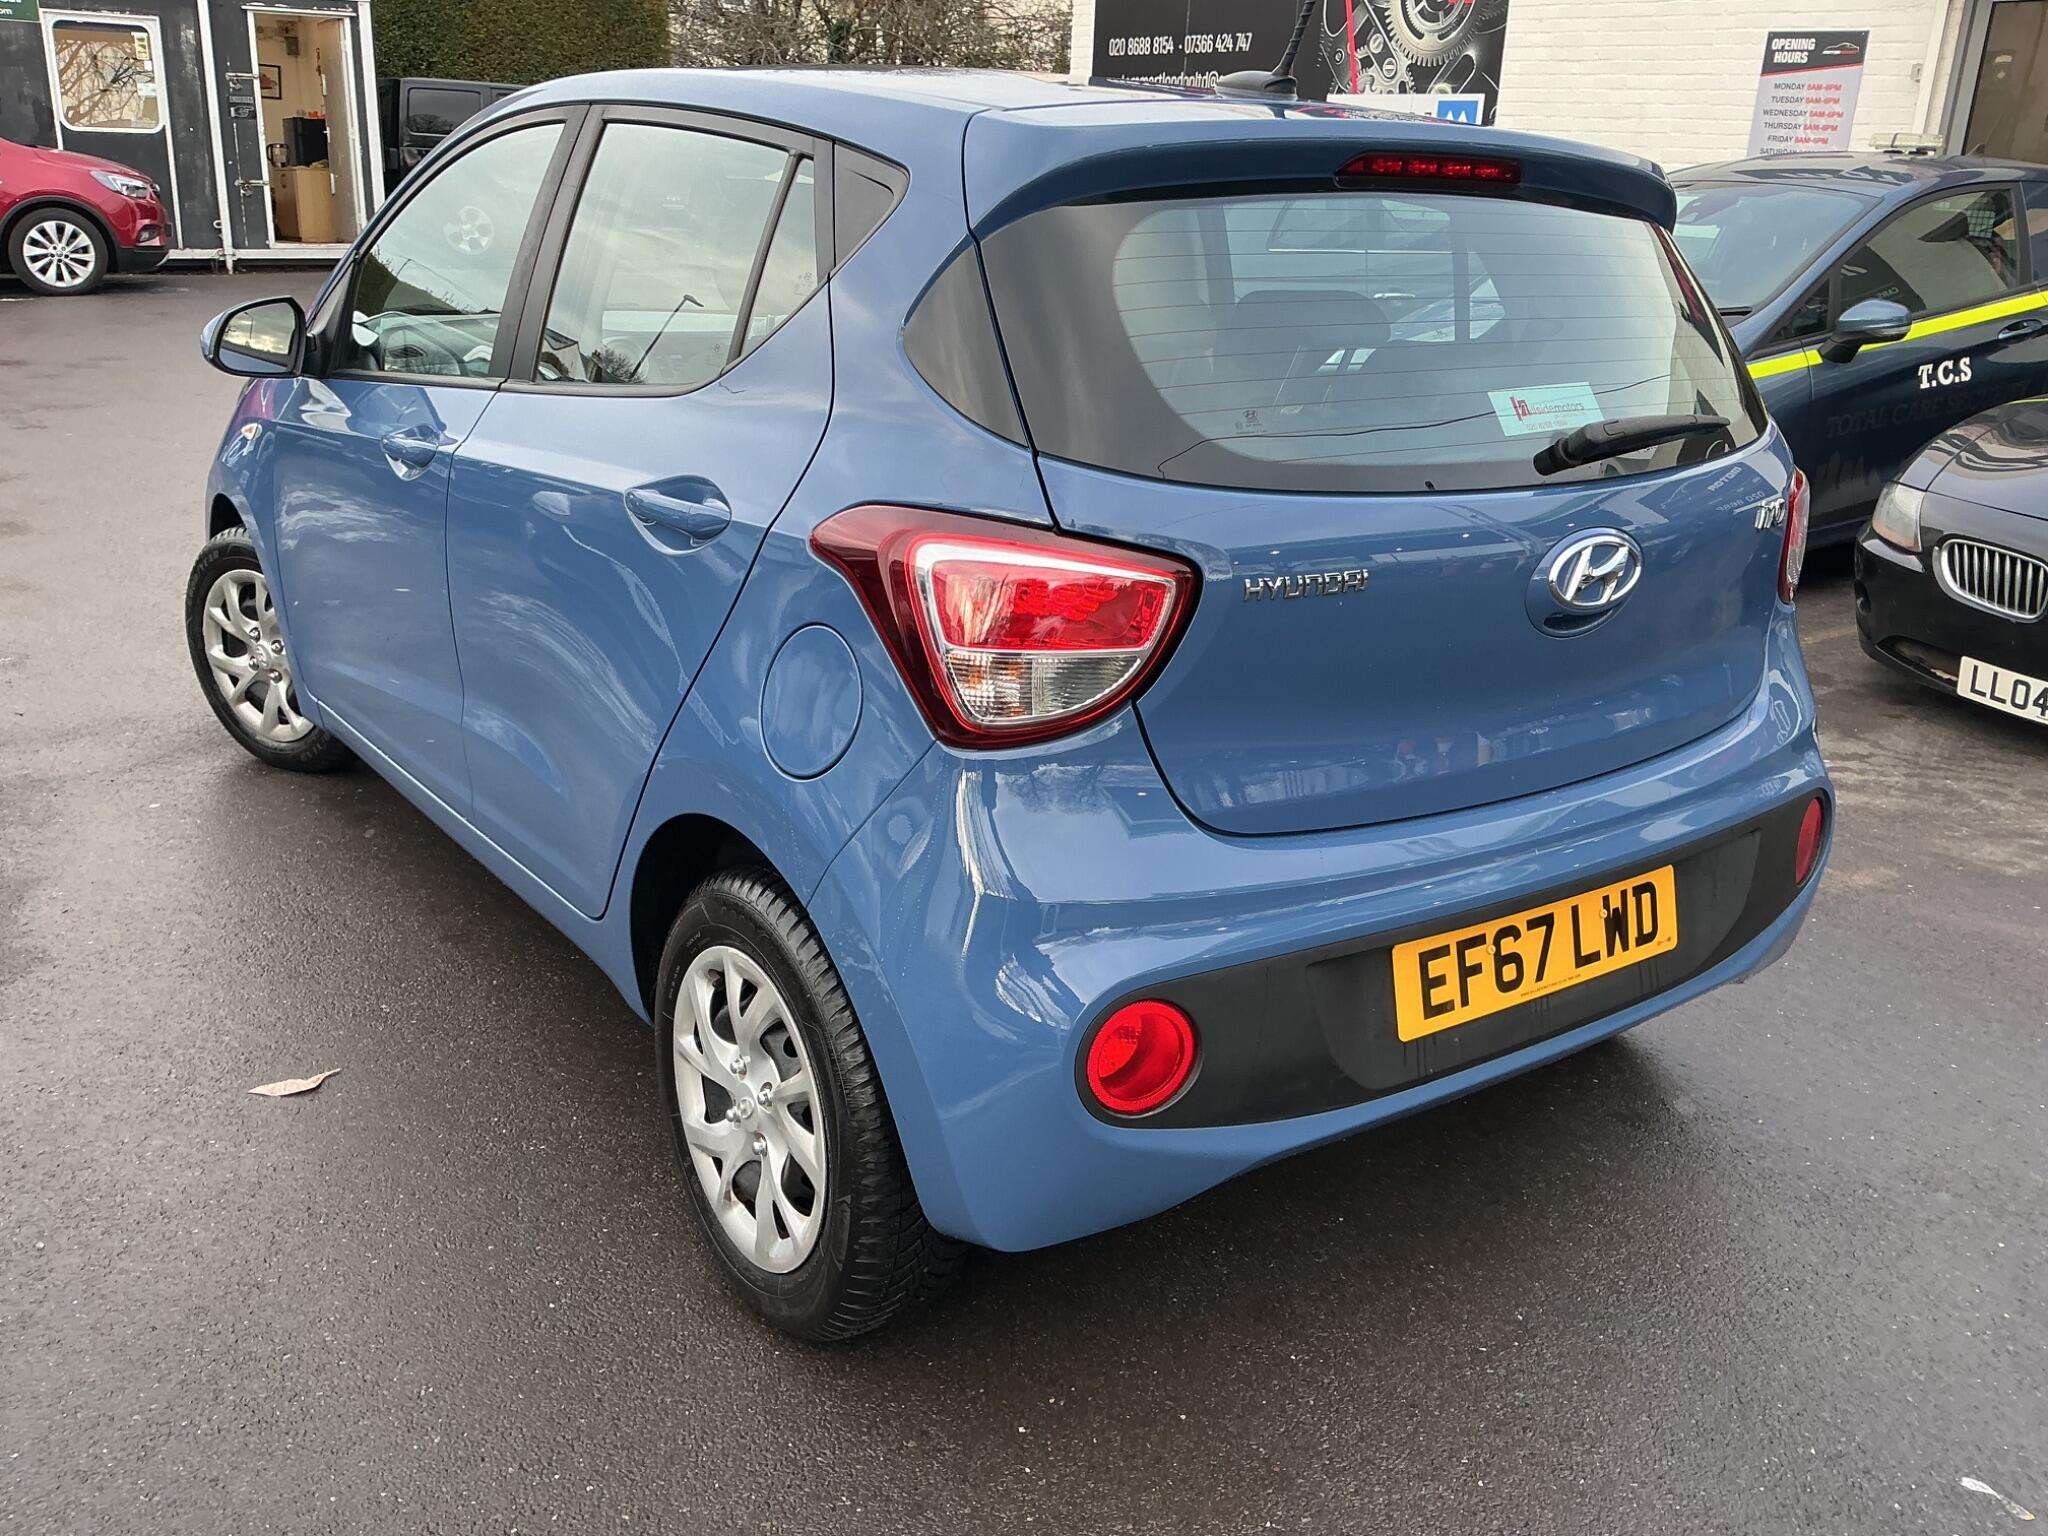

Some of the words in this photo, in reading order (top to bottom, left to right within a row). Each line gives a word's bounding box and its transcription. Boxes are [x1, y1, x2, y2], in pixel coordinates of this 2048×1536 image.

[1109, 38, 1126, 56] 020
[1127, 37, 1151, 55] 8688
[1153, 36, 1174, 55] 8154
[1184, 34, 1214, 54] 07366
[1215, 33, 1234, 53] 424
[1235, 32, 1253, 52] 747
[1771, 38, 1816, 50] OPENING
[1773, 51, 1809, 64] HOURS
[1762, 109, 1808, 117] WEDNESDAY
[1763, 122, 1802, 130] THURSDAY
[1767, 135, 1794, 143] FRIDAY
[1918, 356, 1972, 390] T.C.S
[1244, 569, 1369, 601] HYUNDAI
[1970, 665, 2048, 716] LL04
[1418, 912, 1555, 1021] EF67
[1571, 881, 1659, 970] LWD
